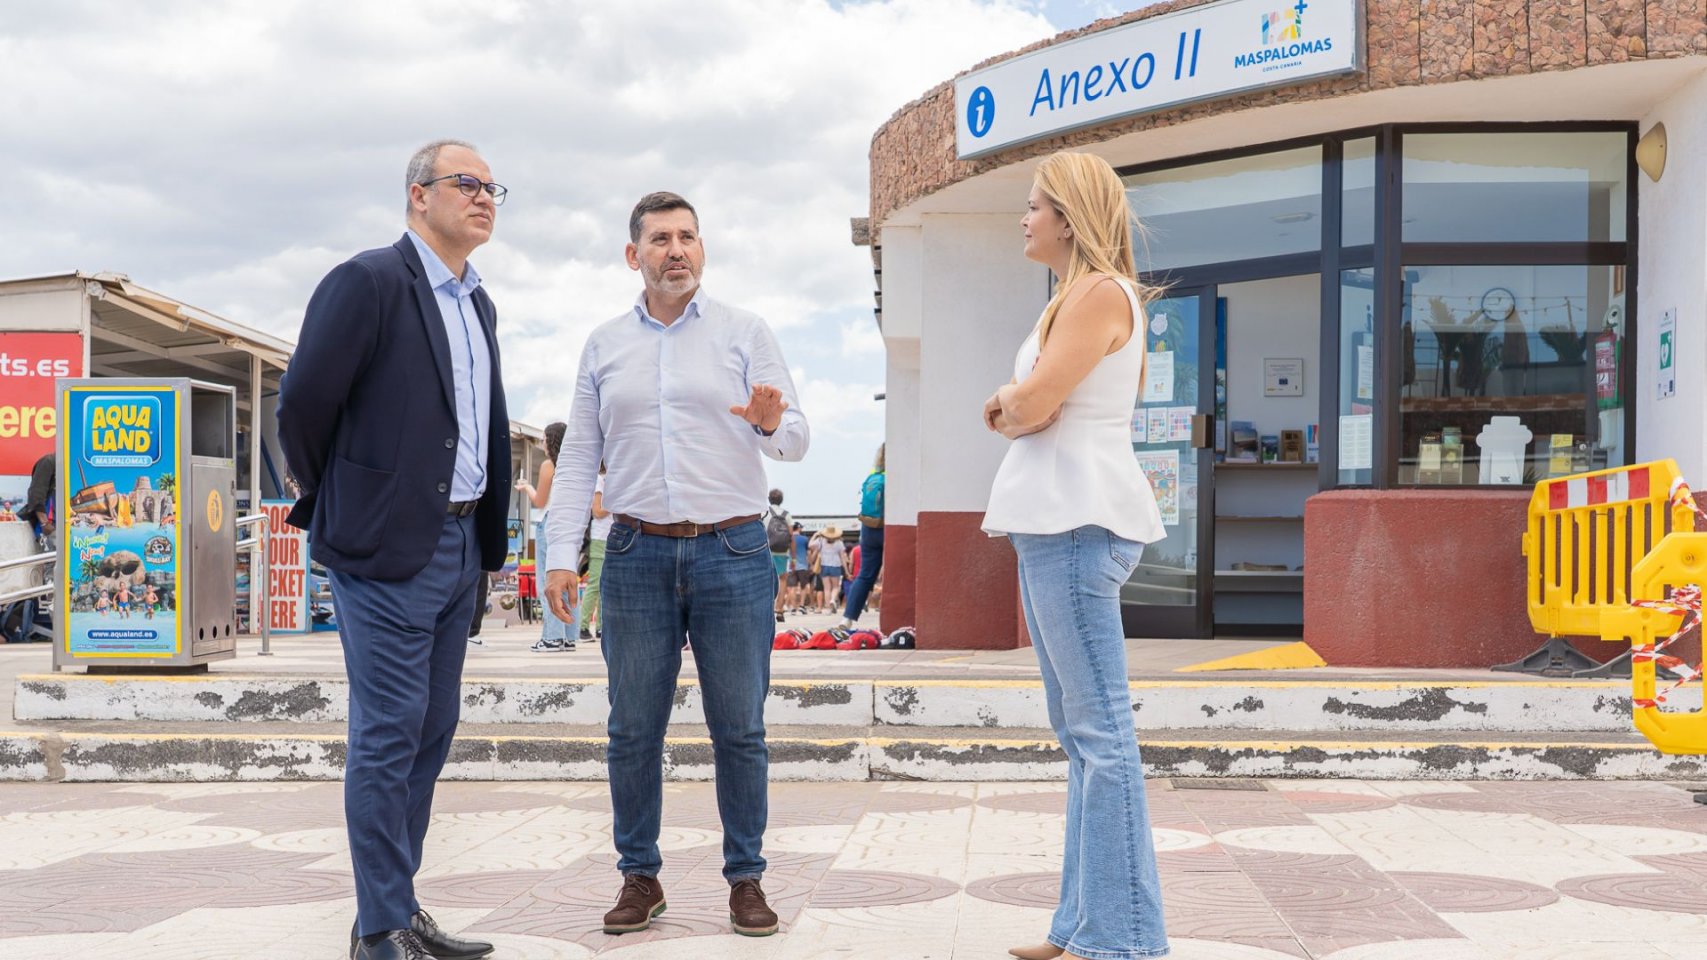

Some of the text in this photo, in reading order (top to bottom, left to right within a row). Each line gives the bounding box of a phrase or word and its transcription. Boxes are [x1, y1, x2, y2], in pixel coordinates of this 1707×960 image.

[1234, 37, 1332, 69] MASPALOMAS
[1029, 28, 1202, 117] Anexo II
[0, 353, 70, 377] ts.es
[92, 405, 152, 430] AQUA
[92, 429, 151, 453] LAND
[95, 457, 149, 466] MASPALOMAS
[260, 537, 299, 566] OUR
[264, 569, 305, 597] CKET
[260, 600, 297, 629] ERE
[92, 630, 153, 639] www.aqualand.es
